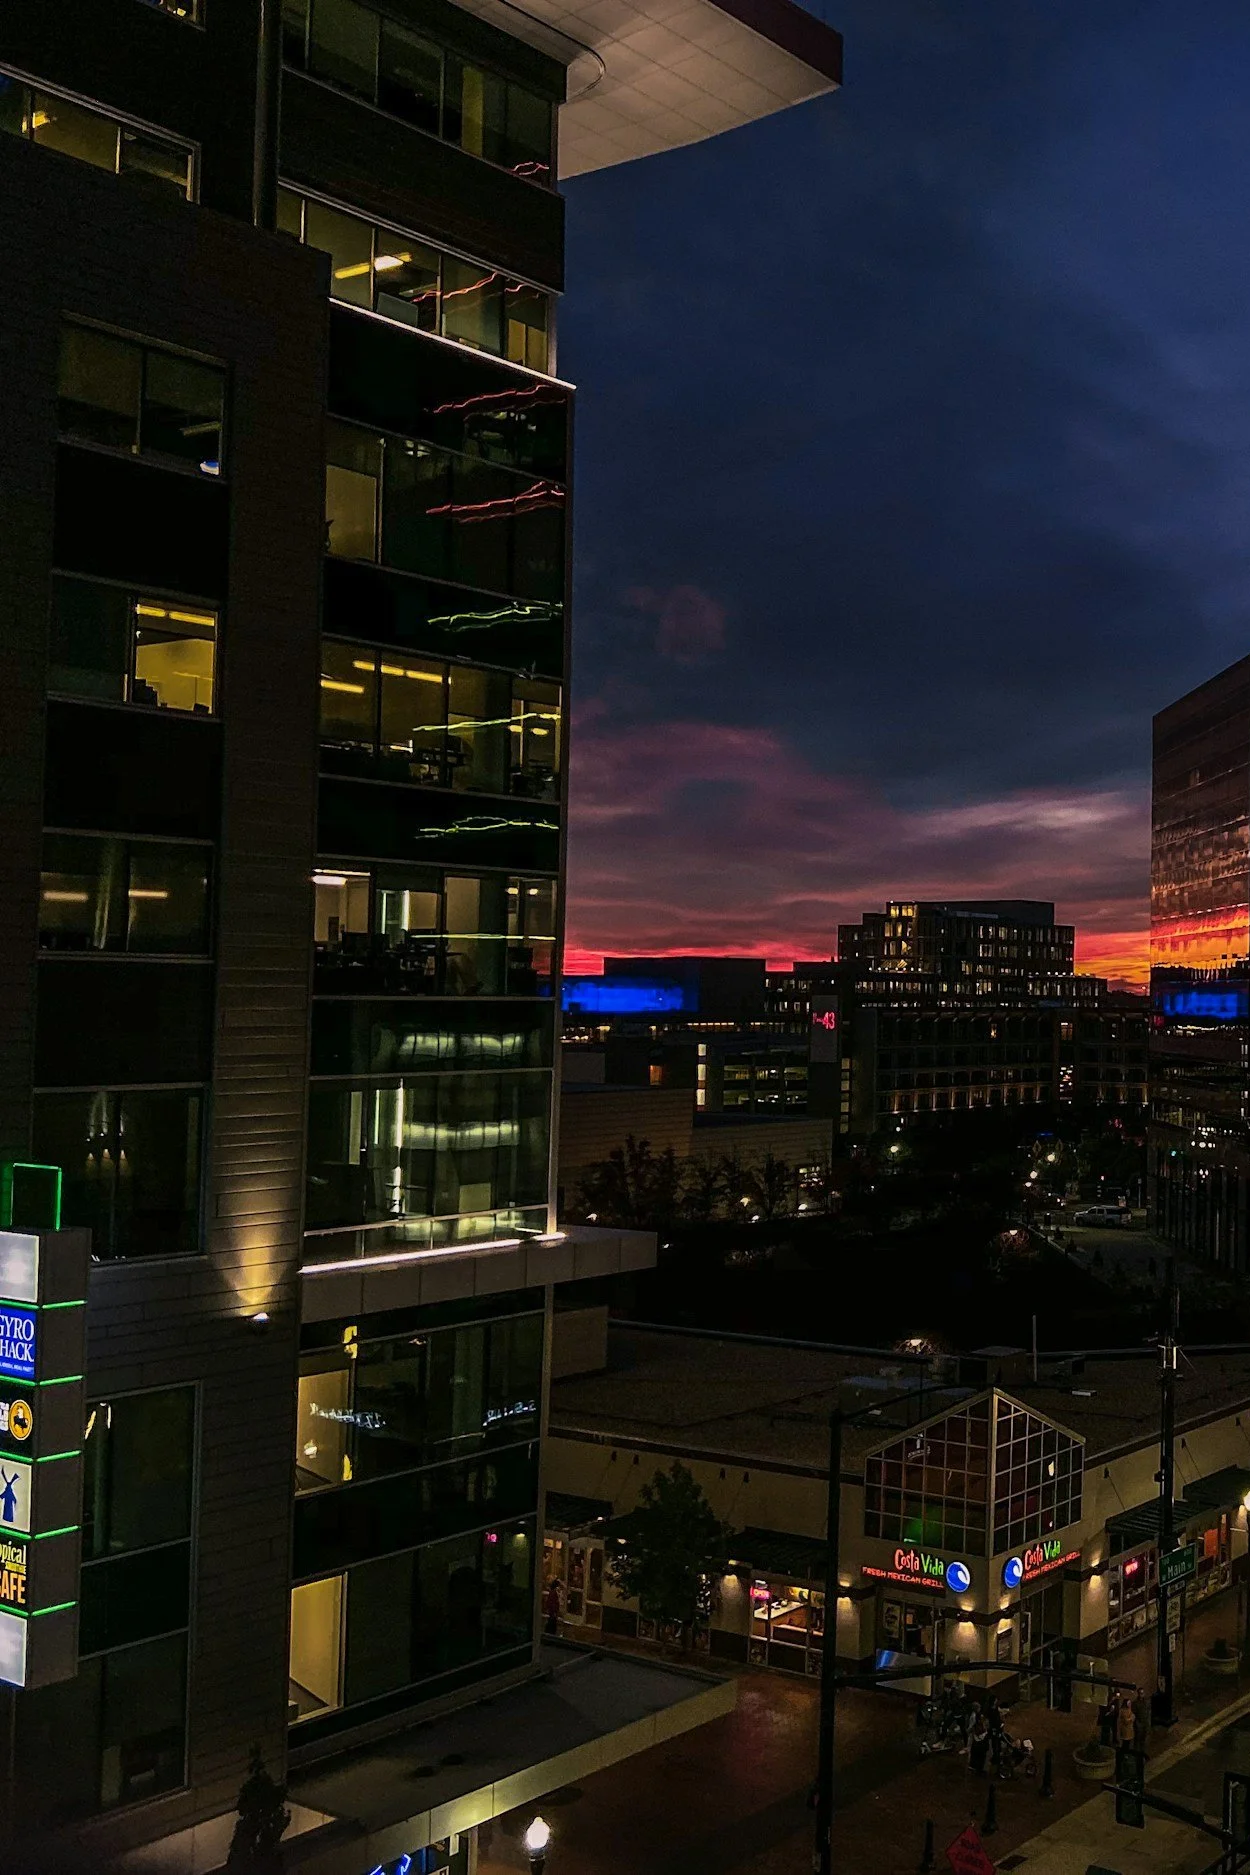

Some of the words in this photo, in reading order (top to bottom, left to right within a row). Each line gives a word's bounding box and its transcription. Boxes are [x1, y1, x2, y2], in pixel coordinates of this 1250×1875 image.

[894, 1549, 919, 1572] Costa
[920, 1553, 944, 1575] Vida
[1024, 1544, 1043, 1571] Costa
[1043, 1540, 1060, 1560] Vida
[862, 1566, 886, 1578] FRESH
[887, 1571, 921, 1584] MEXICAN
[921, 1577, 944, 1588] GRILL
[1167, 1561, 1186, 1580] Main
